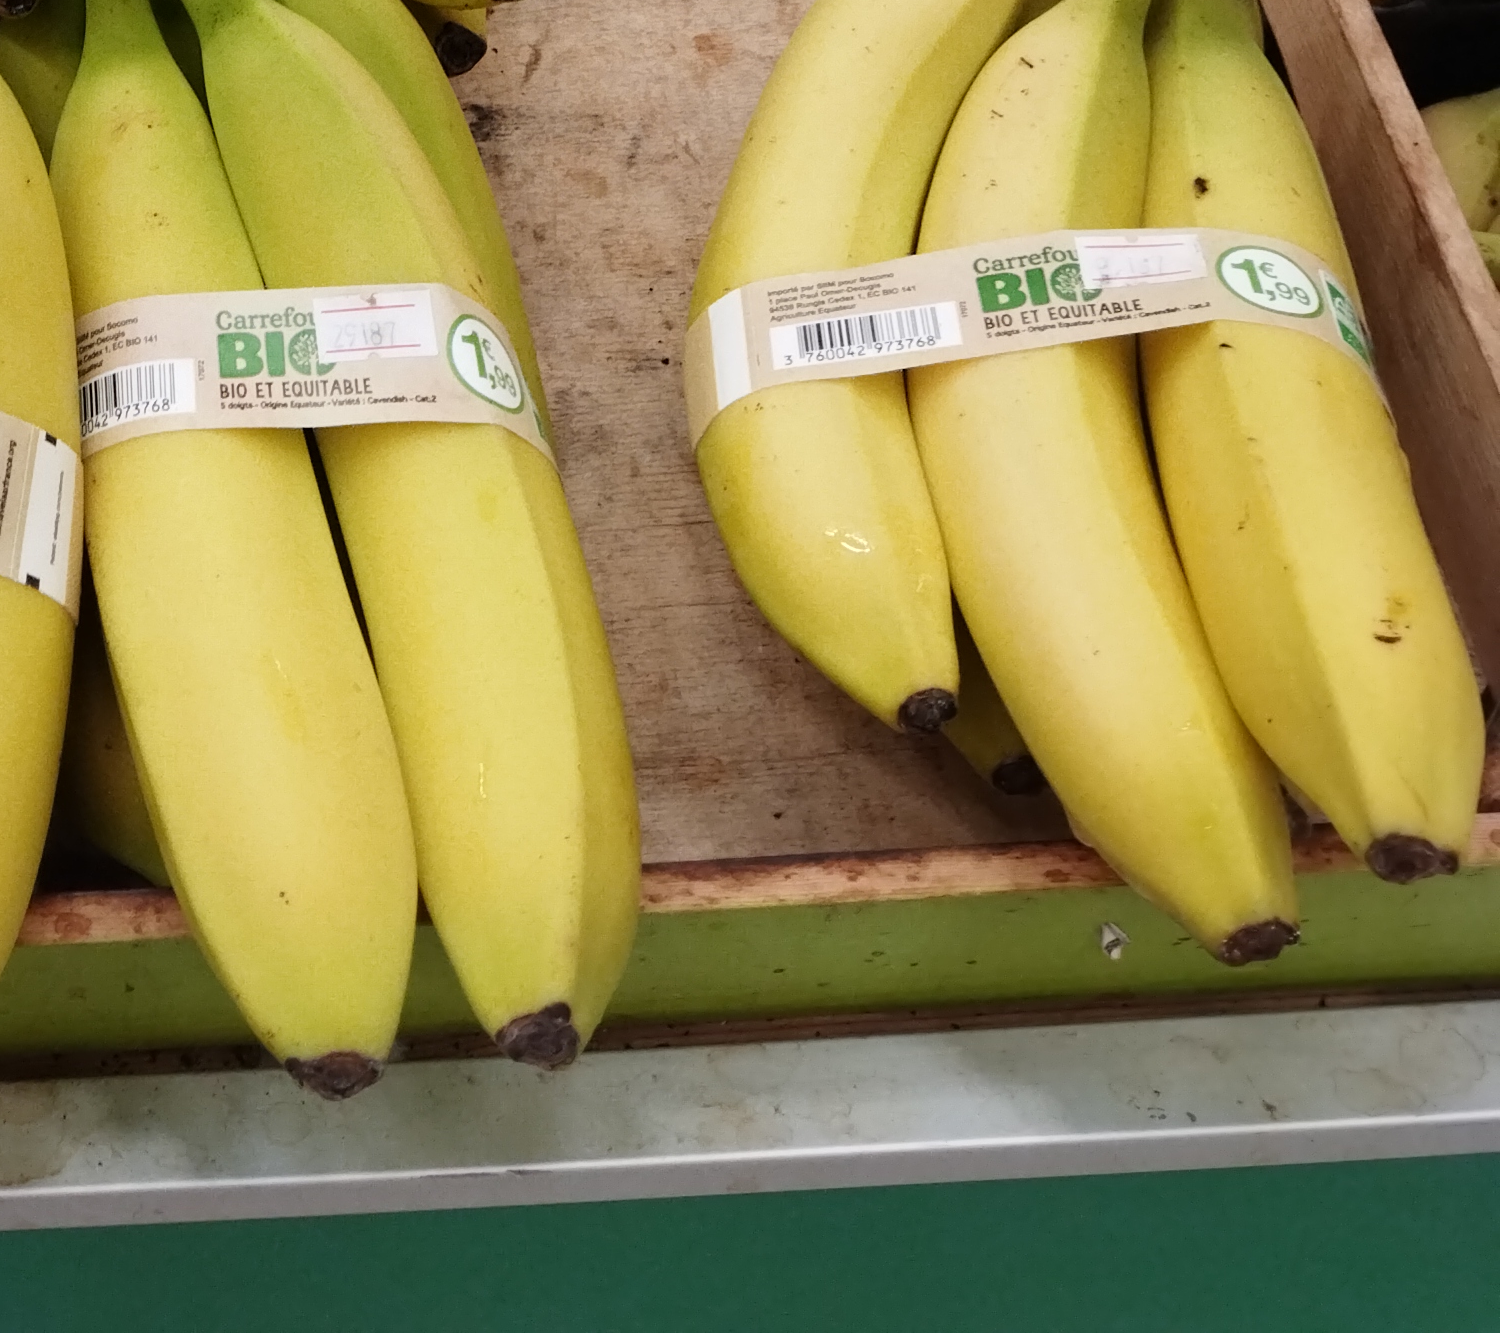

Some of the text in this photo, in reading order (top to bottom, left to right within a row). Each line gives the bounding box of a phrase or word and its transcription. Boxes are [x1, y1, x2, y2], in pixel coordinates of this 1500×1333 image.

[973, 246, 1080, 275] Carrefou
[976, 262, 1104, 314] BIO
[983, 299, 1143, 331] BIO ET EQUITABLE
[113, 335, 158, 351] EC BIO 141
[217, 329, 338, 378] BIO
[784, 335, 936, 366] 3 760042 973768
[220, 378, 373, 399] BIO ET EQUITABLE
[227, 401, 253, 410] doigts
[260, 400, 288, 410] Origine
[290, 400, 325, 409] Equateur
[367, 395, 408, 405] Cavendish
[115, 398, 170, 421] 973768
